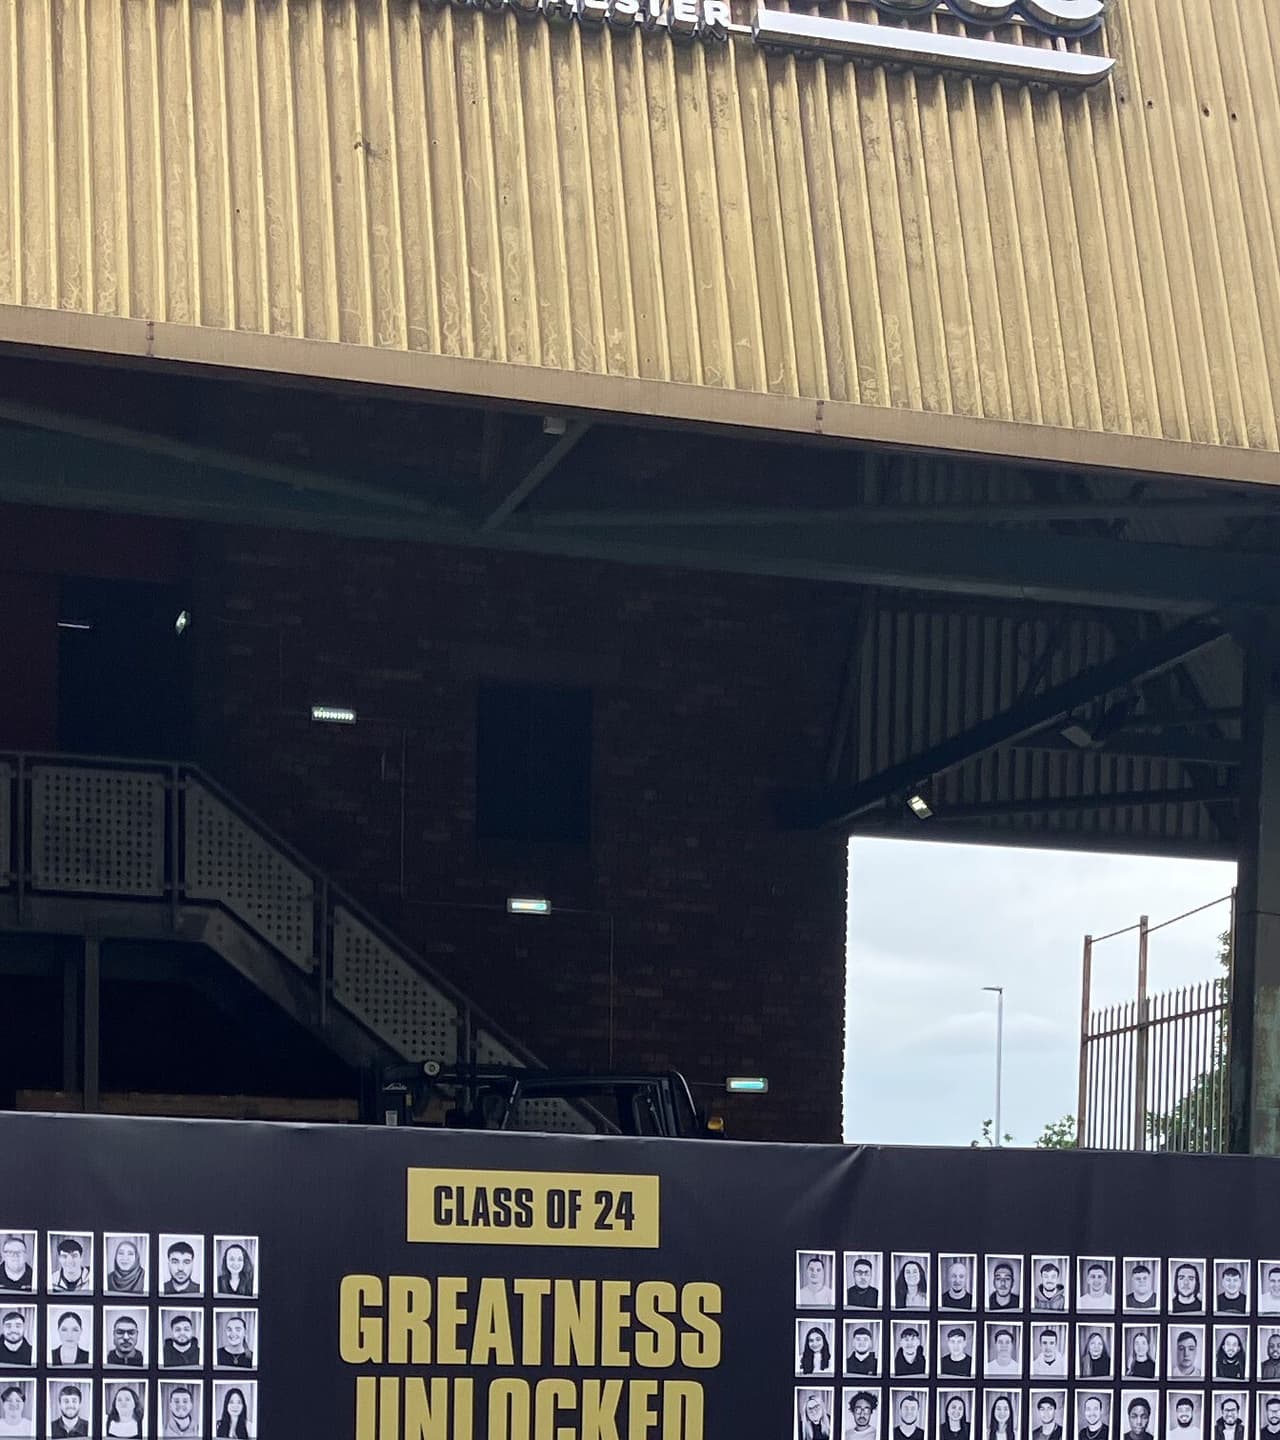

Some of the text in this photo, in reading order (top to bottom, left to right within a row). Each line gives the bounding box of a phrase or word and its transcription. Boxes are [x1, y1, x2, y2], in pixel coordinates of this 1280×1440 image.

[433, 1185, 635, 1231] CLASS OF 24
[338, 1274, 722, 1368] GREATNESS
